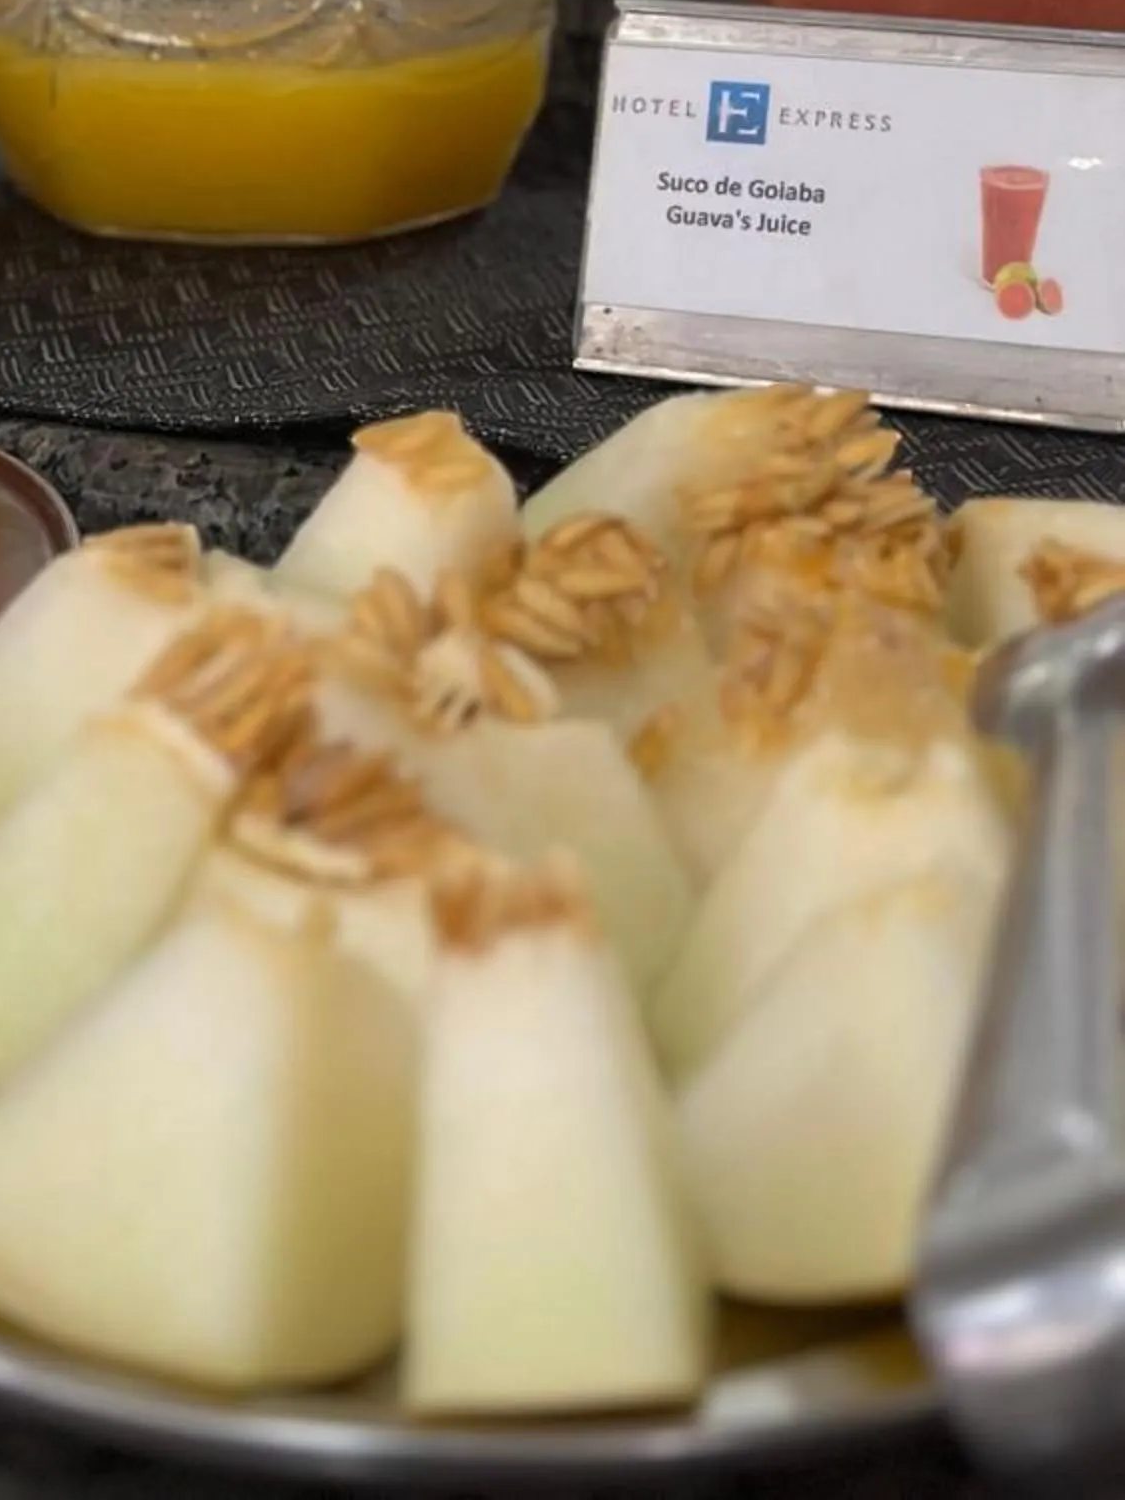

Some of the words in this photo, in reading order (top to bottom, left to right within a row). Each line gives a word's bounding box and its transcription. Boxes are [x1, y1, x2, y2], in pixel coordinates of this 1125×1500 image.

[612, 94, 697, 119] HOTEL
[779, 107, 893, 133] EXPRESS
[657, 171, 708, 195] Suco
[715, 175, 742, 197] de
[748, 179, 825, 204] Goiaba
[666, 205, 751, 231] Guava's
[756, 213, 812, 236] Juice
